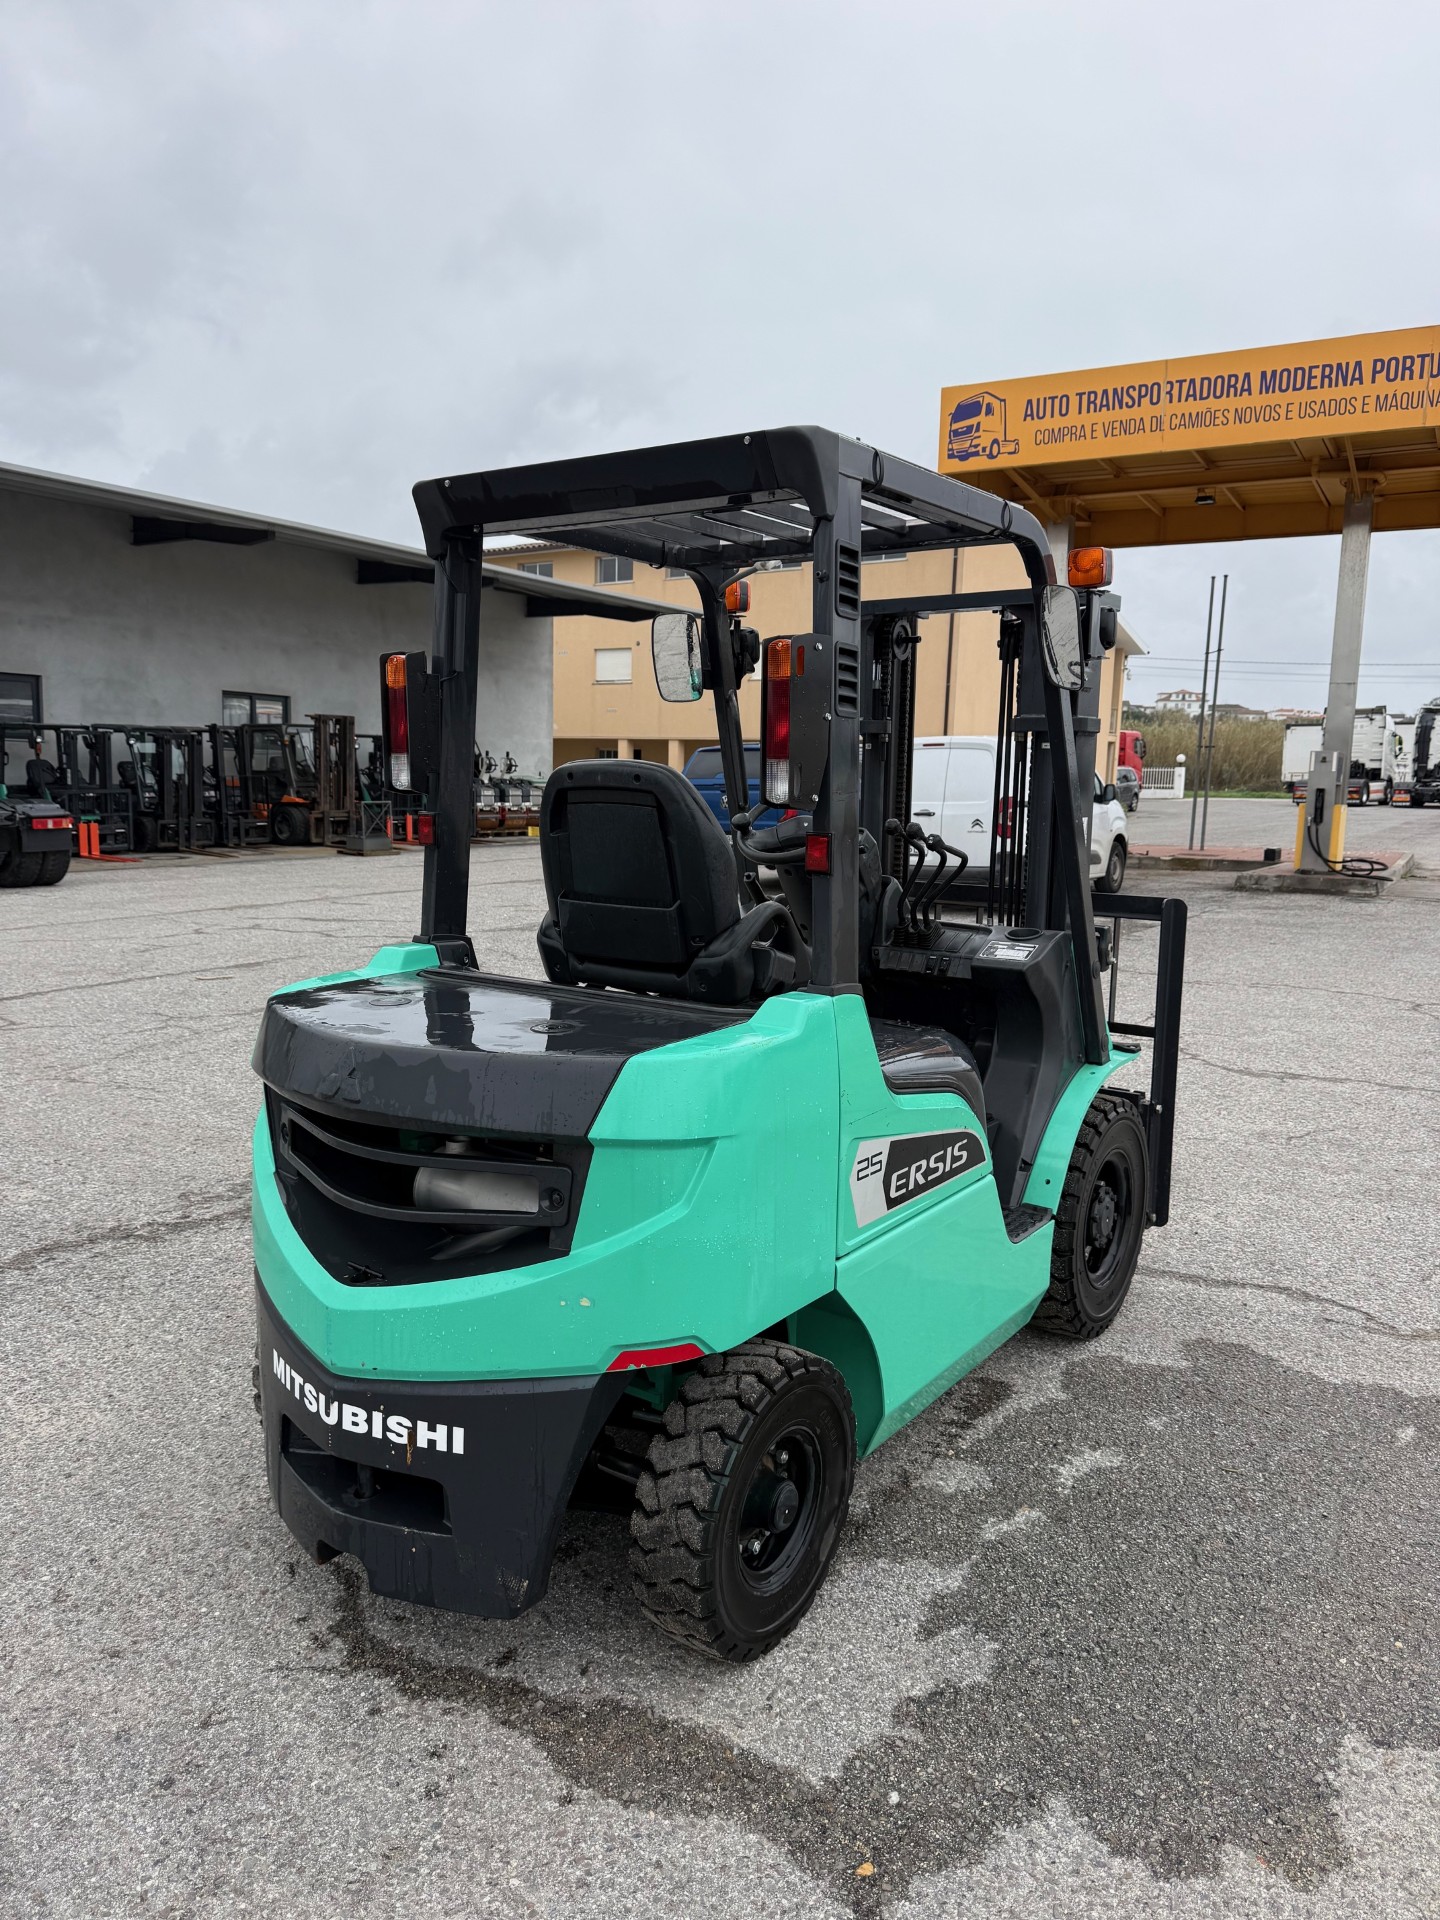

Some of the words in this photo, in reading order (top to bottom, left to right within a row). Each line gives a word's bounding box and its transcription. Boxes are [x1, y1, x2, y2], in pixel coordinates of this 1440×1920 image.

[1023, 394, 1070, 422] AUTO
[1075, 372, 1253, 415] TRANSPORTADORA
[1258, 360, 1364, 395] MODERNA
[1371, 352, 1440, 384] PORTU
[1034, 424, 1087, 446] COMPRA
[1090, 422, 1099, 440] E
[1102, 417, 1146, 438] VENDA
[1169, 407, 1230, 431] CAMIÕES
[1233, 403, 1282, 425] NOVOS
[1285, 402, 1295, 420] E
[1298, 396, 1358, 419] USADOS
[1361, 395, 1371, 414] E
[857, 1151, 883, 1182] 25
[889, 1138, 968, 1199] ERSIS
[273, 1348, 465, 1455] MITSUBISHI
